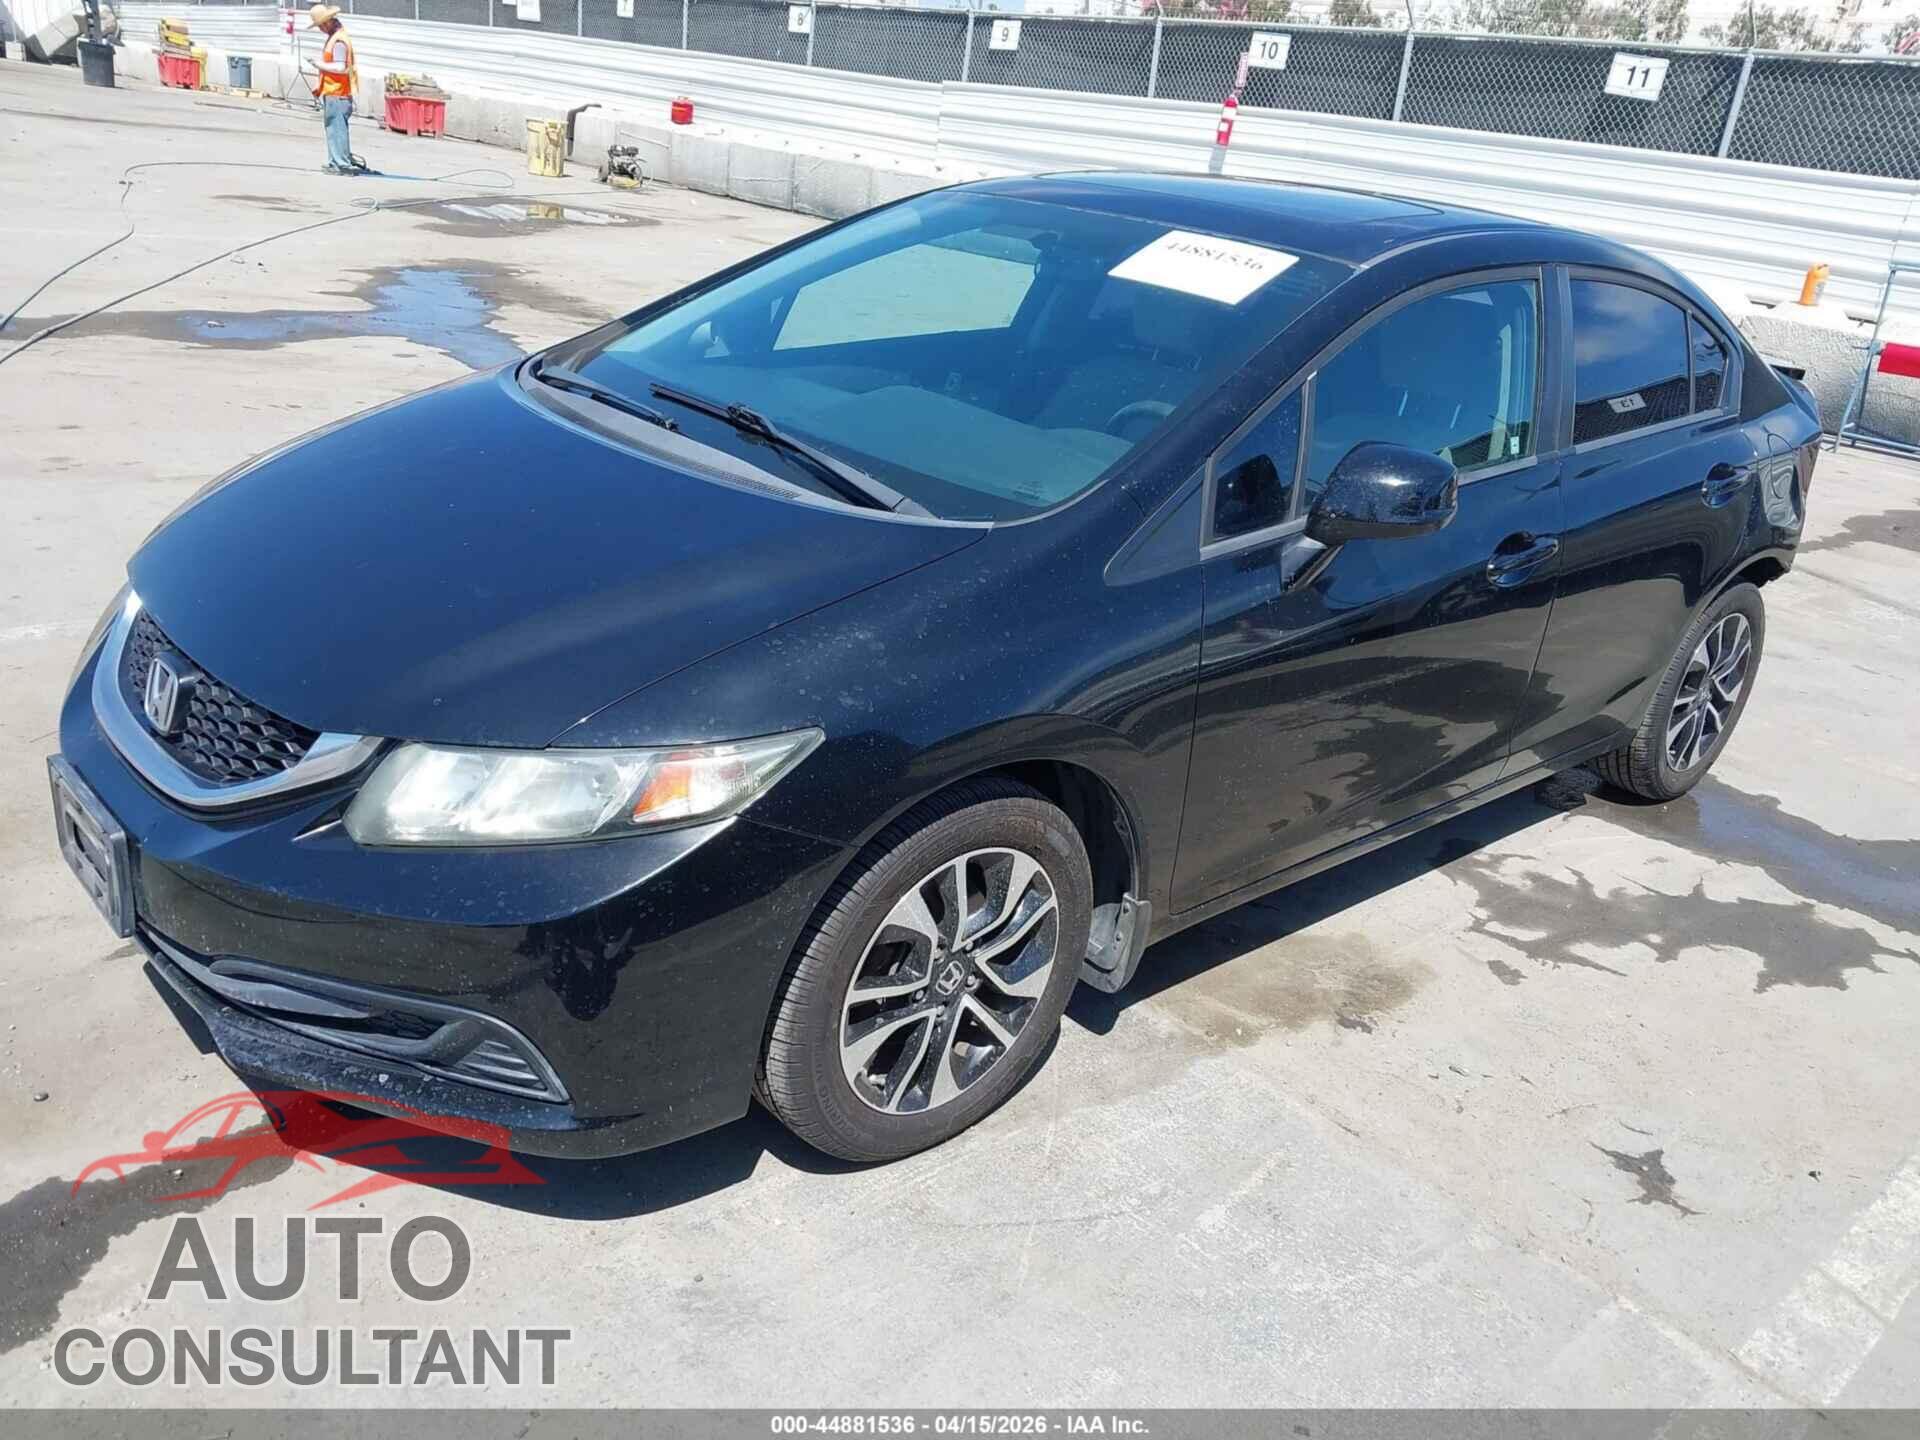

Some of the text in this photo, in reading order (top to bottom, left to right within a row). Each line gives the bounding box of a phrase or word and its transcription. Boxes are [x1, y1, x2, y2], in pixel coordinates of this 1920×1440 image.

[1001, 26, 1009, 42] 9
[1260, 41, 1279, 60] 10
[1627, 65, 1651, 88] 11
